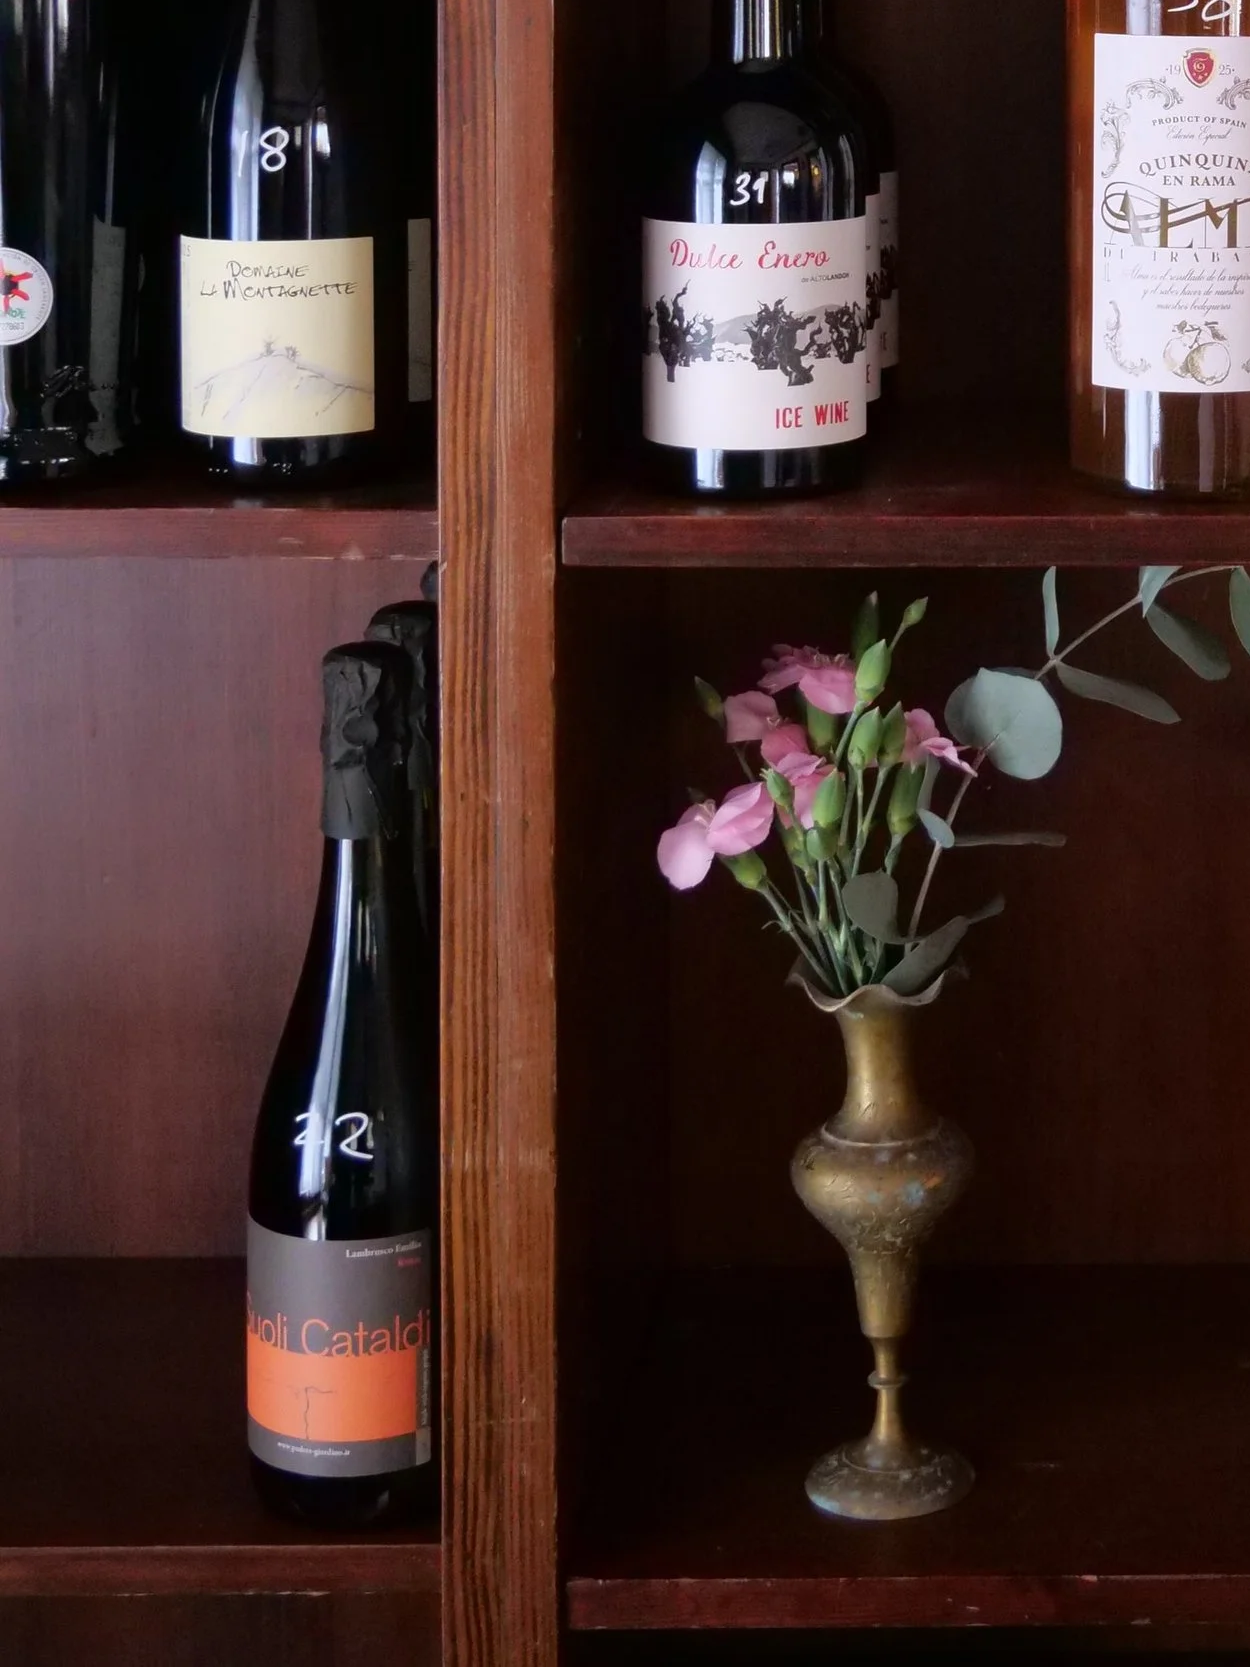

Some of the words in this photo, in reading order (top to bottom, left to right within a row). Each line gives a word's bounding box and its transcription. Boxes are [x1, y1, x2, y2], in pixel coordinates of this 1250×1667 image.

[1152, 116, 1200, 127] PRODUCT
[1219, 117, 1248, 129] SPAIN
[238, 125, 290, 178] 18
[1162, 176, 1183, 186] EN
[1190, 176, 1236, 187] RAMA
[669, 237, 743, 270] Dulce
[757, 239, 831, 270] Enero
[226, 260, 310, 279] DOMAINE
[223, 277, 358, 302] MONTAGNETTE
[775, 406, 804, 430] ICE
[814, 400, 850, 426] WINE
[301, 1308, 431, 1357] Cataldi
